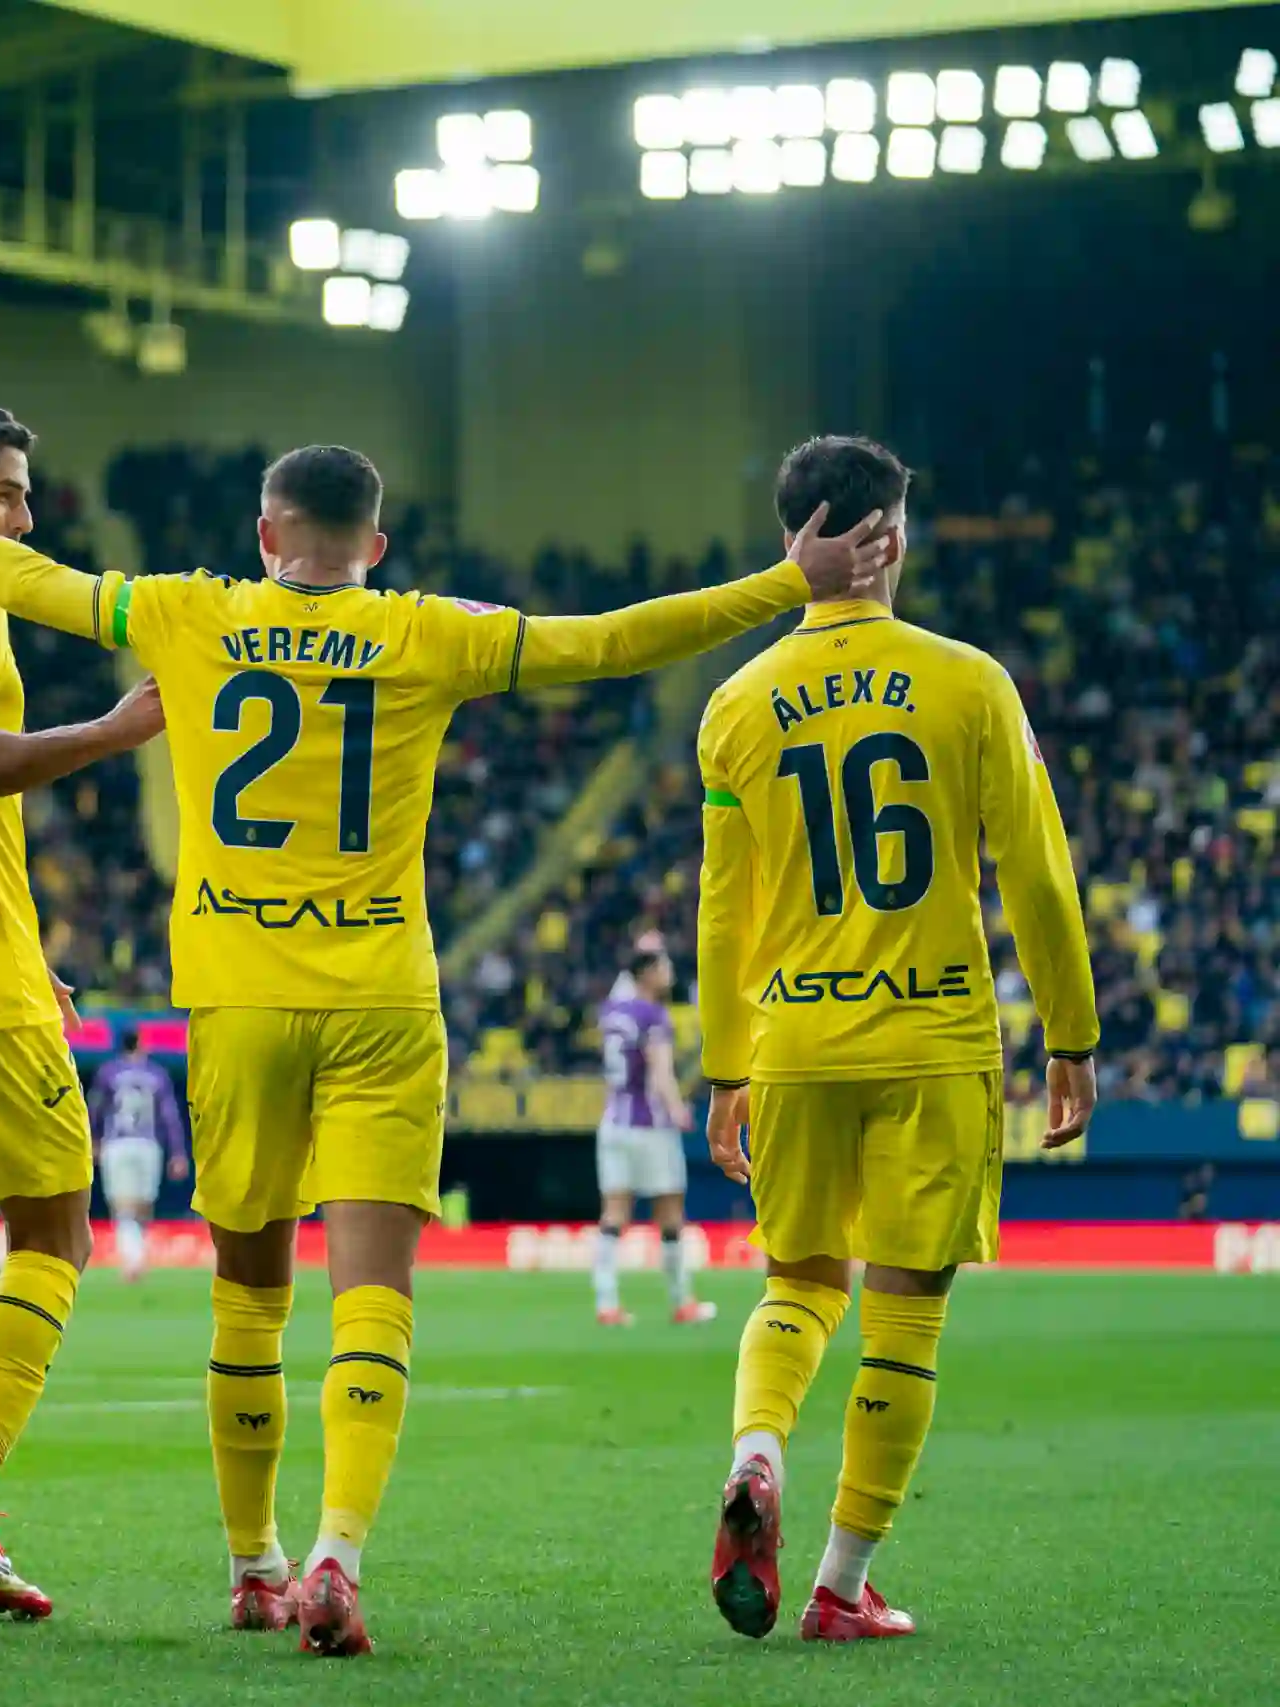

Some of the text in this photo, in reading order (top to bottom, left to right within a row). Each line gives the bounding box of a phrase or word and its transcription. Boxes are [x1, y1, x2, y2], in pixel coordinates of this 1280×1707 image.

[211, 669, 377, 854] 21
[776, 731, 934, 916] 16
[759, 965, 970, 1004] ASCALE
